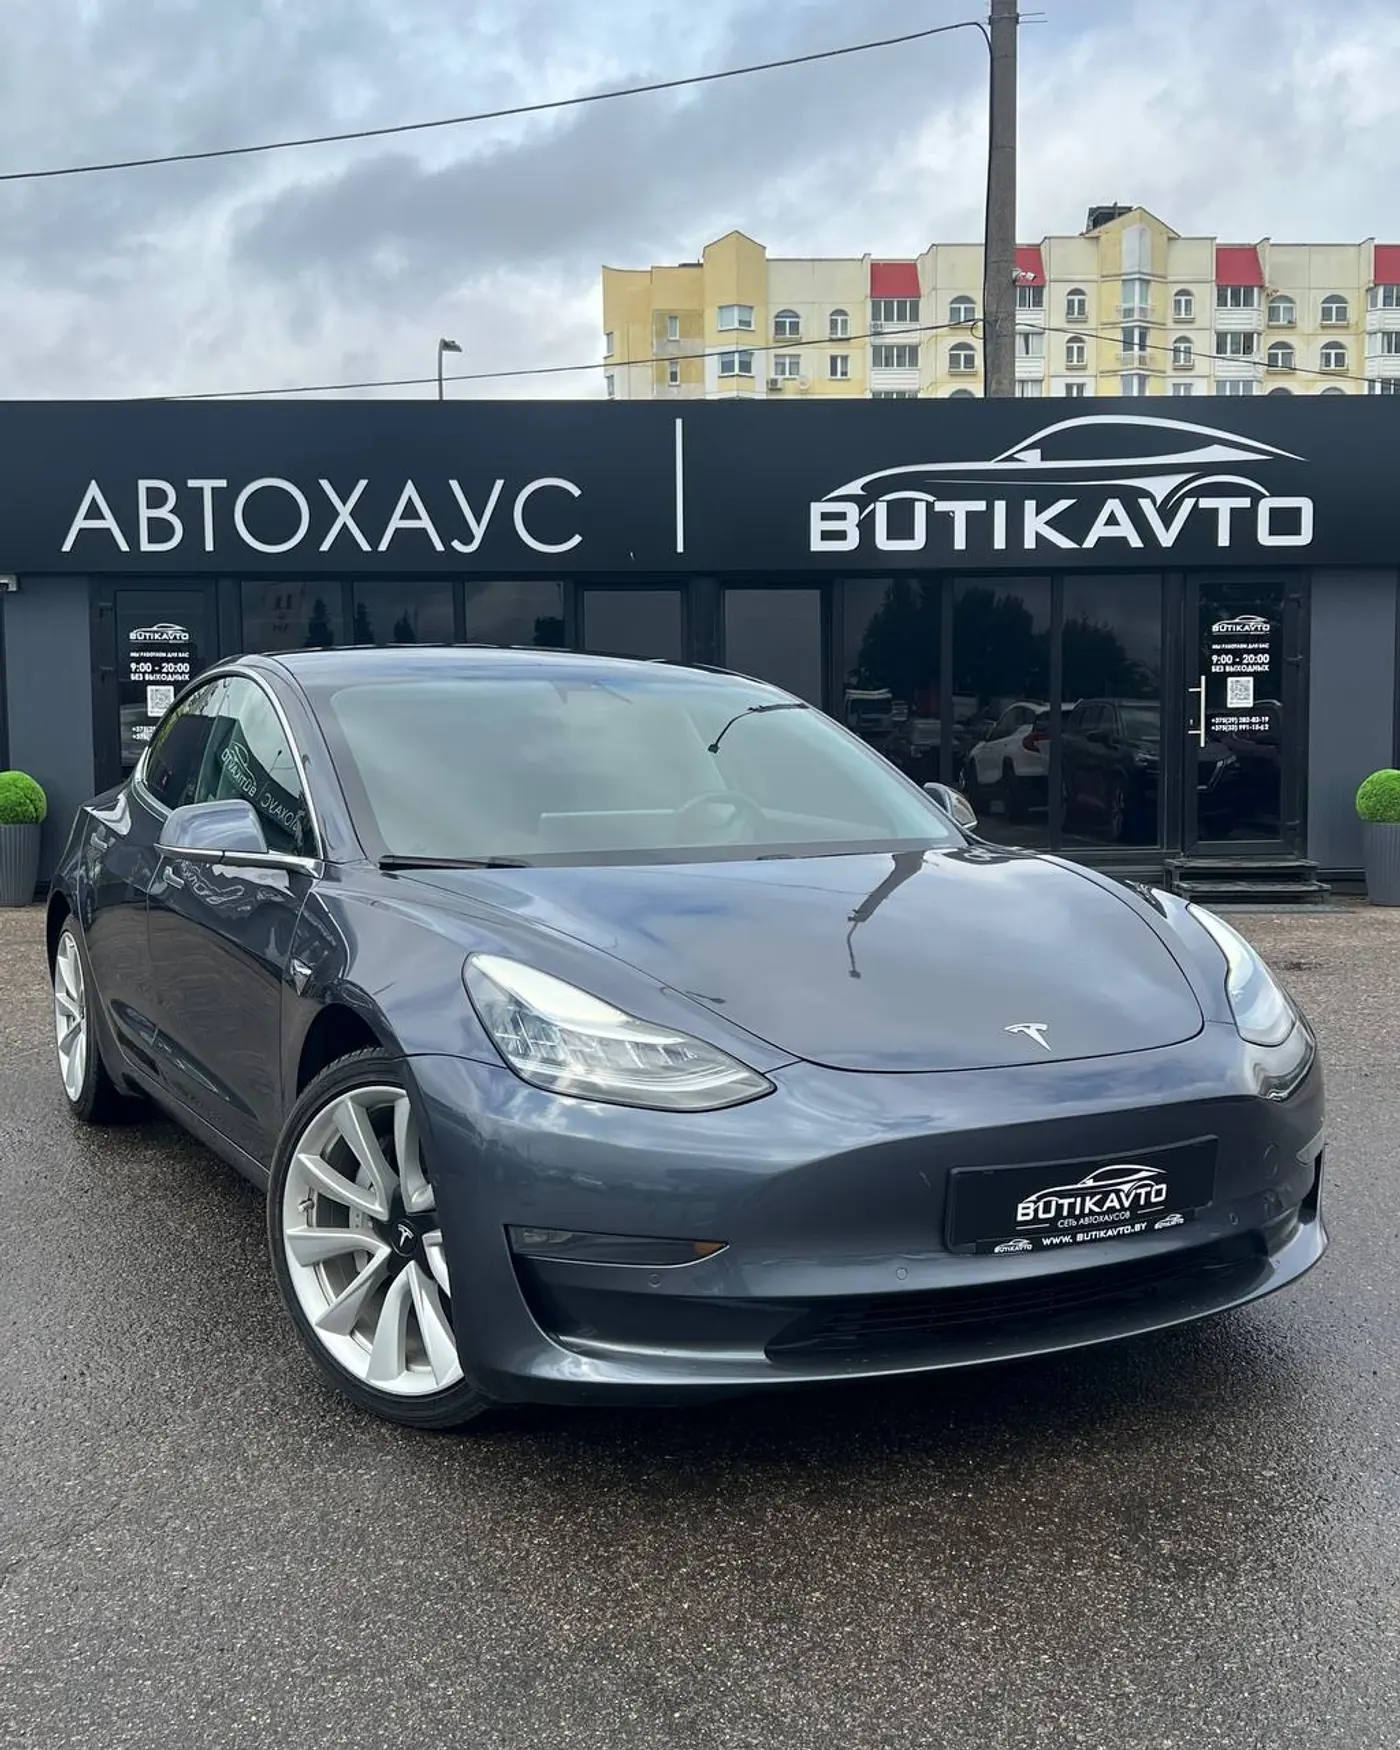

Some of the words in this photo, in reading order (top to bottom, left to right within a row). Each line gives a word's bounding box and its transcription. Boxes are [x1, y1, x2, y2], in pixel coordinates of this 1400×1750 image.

[61, 477, 583, 554] АВТОХАУС
[810, 496, 1314, 552] BUTIKAVTO
[129, 631, 189, 640] BUTIKAVTO
[130, 662, 152, 672] 9:00
[161, 662, 190, 672] 20:00
[1212, 654, 1233, 664] 9:00
[1242, 653, 1270, 664] 20:00
[1016, 1183, 1168, 1222] BUTIKAVTO
[1057, 1219, 1077, 1228] СЕТЬ
[1078, 1211, 1131, 1226] АВТОХАУСОВ
[1041, 1235, 1073, 1246] WWW.
[1076, 1222, 1148, 1242] BUTIKAVTO.BY
